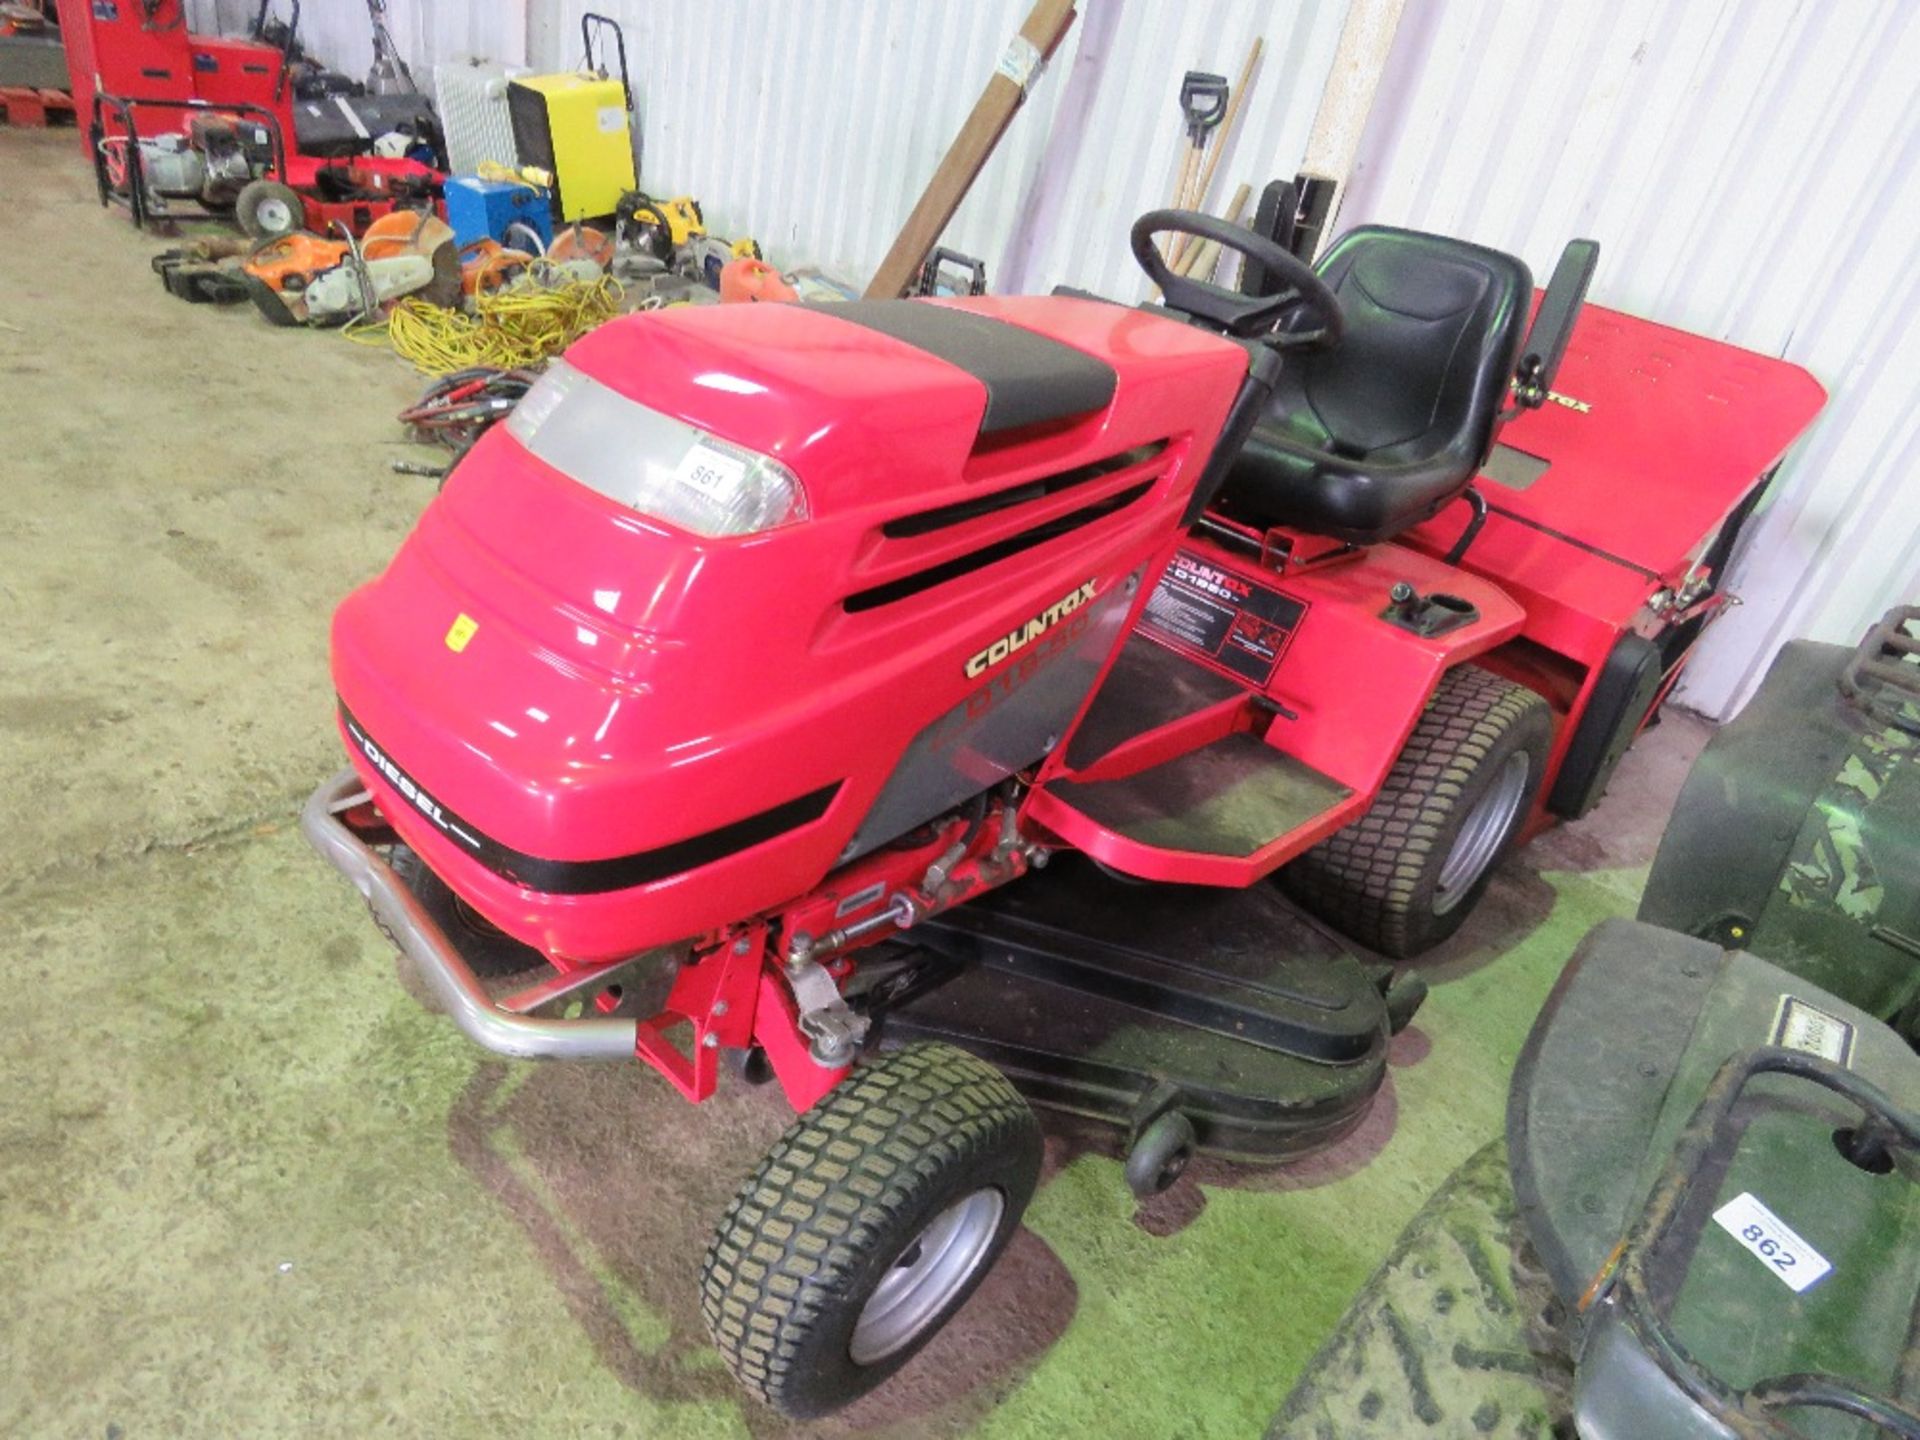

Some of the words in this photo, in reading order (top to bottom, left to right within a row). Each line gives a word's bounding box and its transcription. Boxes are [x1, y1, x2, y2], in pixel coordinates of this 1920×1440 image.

[965, 578, 1097, 679] COUNTAX
[364, 738, 449, 829] DIESEL
[1741, 1224, 1797, 1272] 862
